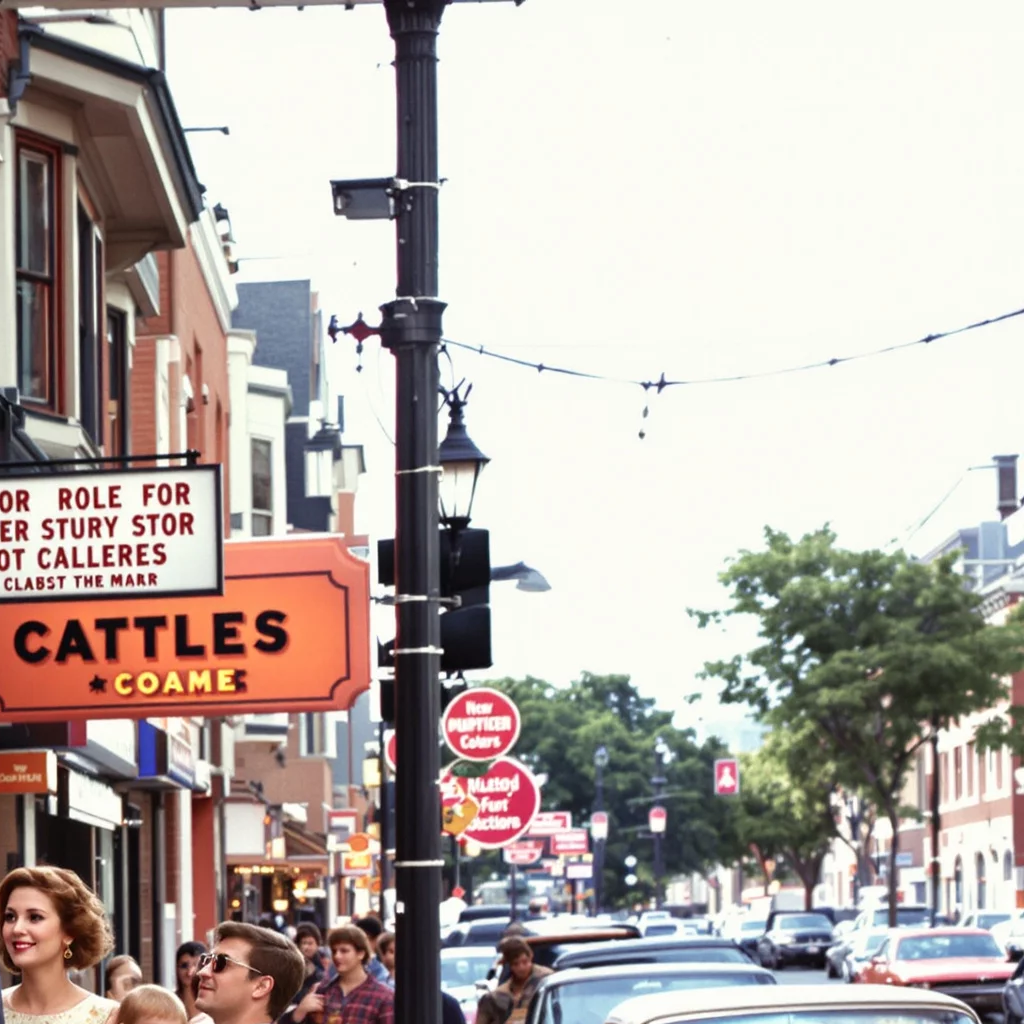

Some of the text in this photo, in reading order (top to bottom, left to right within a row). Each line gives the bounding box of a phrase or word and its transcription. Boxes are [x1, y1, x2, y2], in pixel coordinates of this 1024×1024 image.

[58, 485, 122, 510] ROLE
[143, 483, 190, 506] FOR
[41, 515, 118, 541] STURY
[132, 512, 194, 537] STOR
[37, 543, 167, 569] CALLERES
[73, 574, 104, 589] THE
[14, 610, 288, 664] CATTLES
[114, 669, 238, 695] COAME
